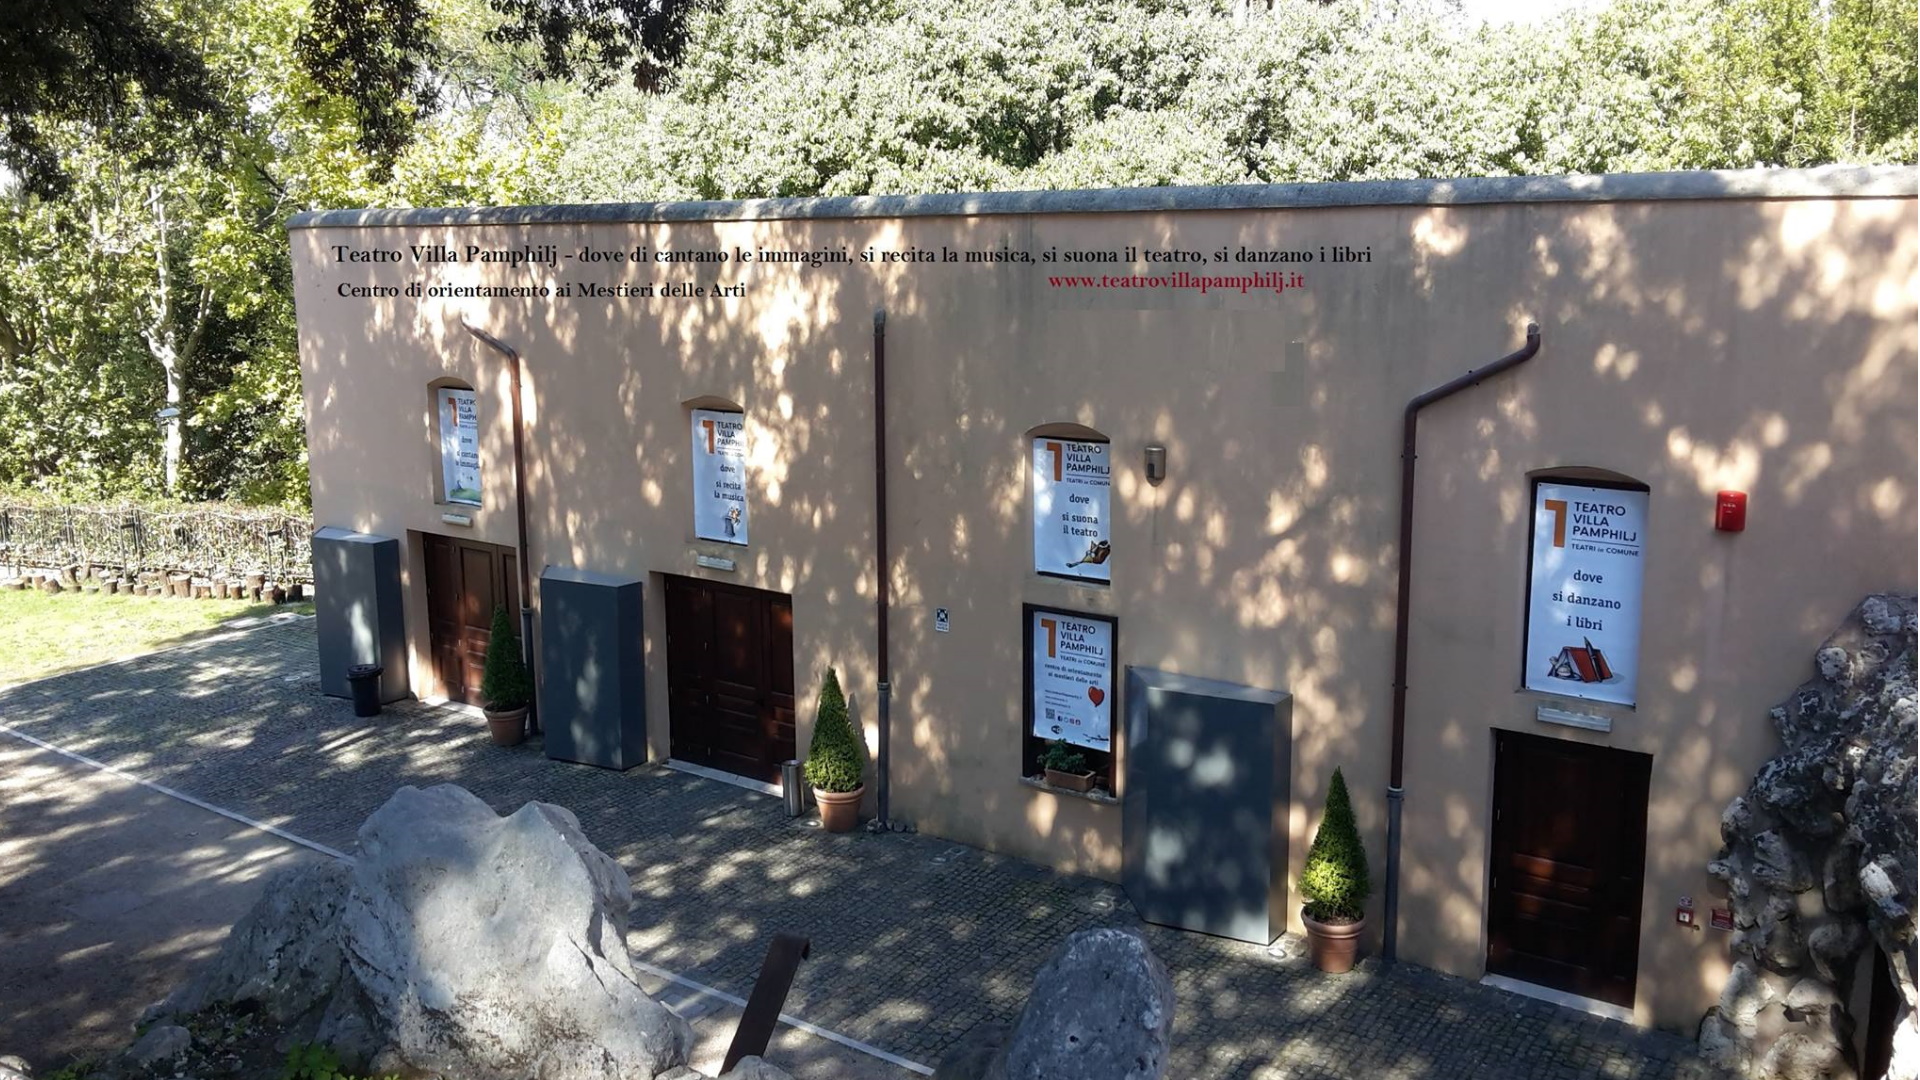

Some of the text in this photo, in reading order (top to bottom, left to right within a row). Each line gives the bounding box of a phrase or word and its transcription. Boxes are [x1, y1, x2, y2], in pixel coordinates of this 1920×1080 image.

[717, 421, 743, 431] TEATRO
[717, 429, 736, 438] VILLA
[1066, 442, 1101, 454] TEATRO
[1066, 453, 1091, 463] VILLA
[720, 464, 736, 474] dove
[1066, 462, 1110, 475] PAMPHILJ
[723, 481, 742, 491] recita
[714, 490, 744, 502] la musica
[1069, 493, 1090, 504] dove
[1574, 501, 1626, 516] TEATRO
[1062, 512, 1098, 525] si suona
[1573, 513, 1609, 526] VILLA
[1063, 524, 1098, 538] il teatro
[1572, 525, 1637, 542] PAMPHILJ
[1571, 543, 1596, 552] TEATRI
[1605, 547, 1639, 557] COMUNE
[1573, 569, 1603, 584] dove
[1552, 590, 1621, 610] si danzano
[1061, 620, 1096, 635] TEATRO
[1576, 616, 1603, 631] libri
[1060, 630, 1085, 643] VILLA
[1060, 640, 1103, 656] PAMPHILJ
